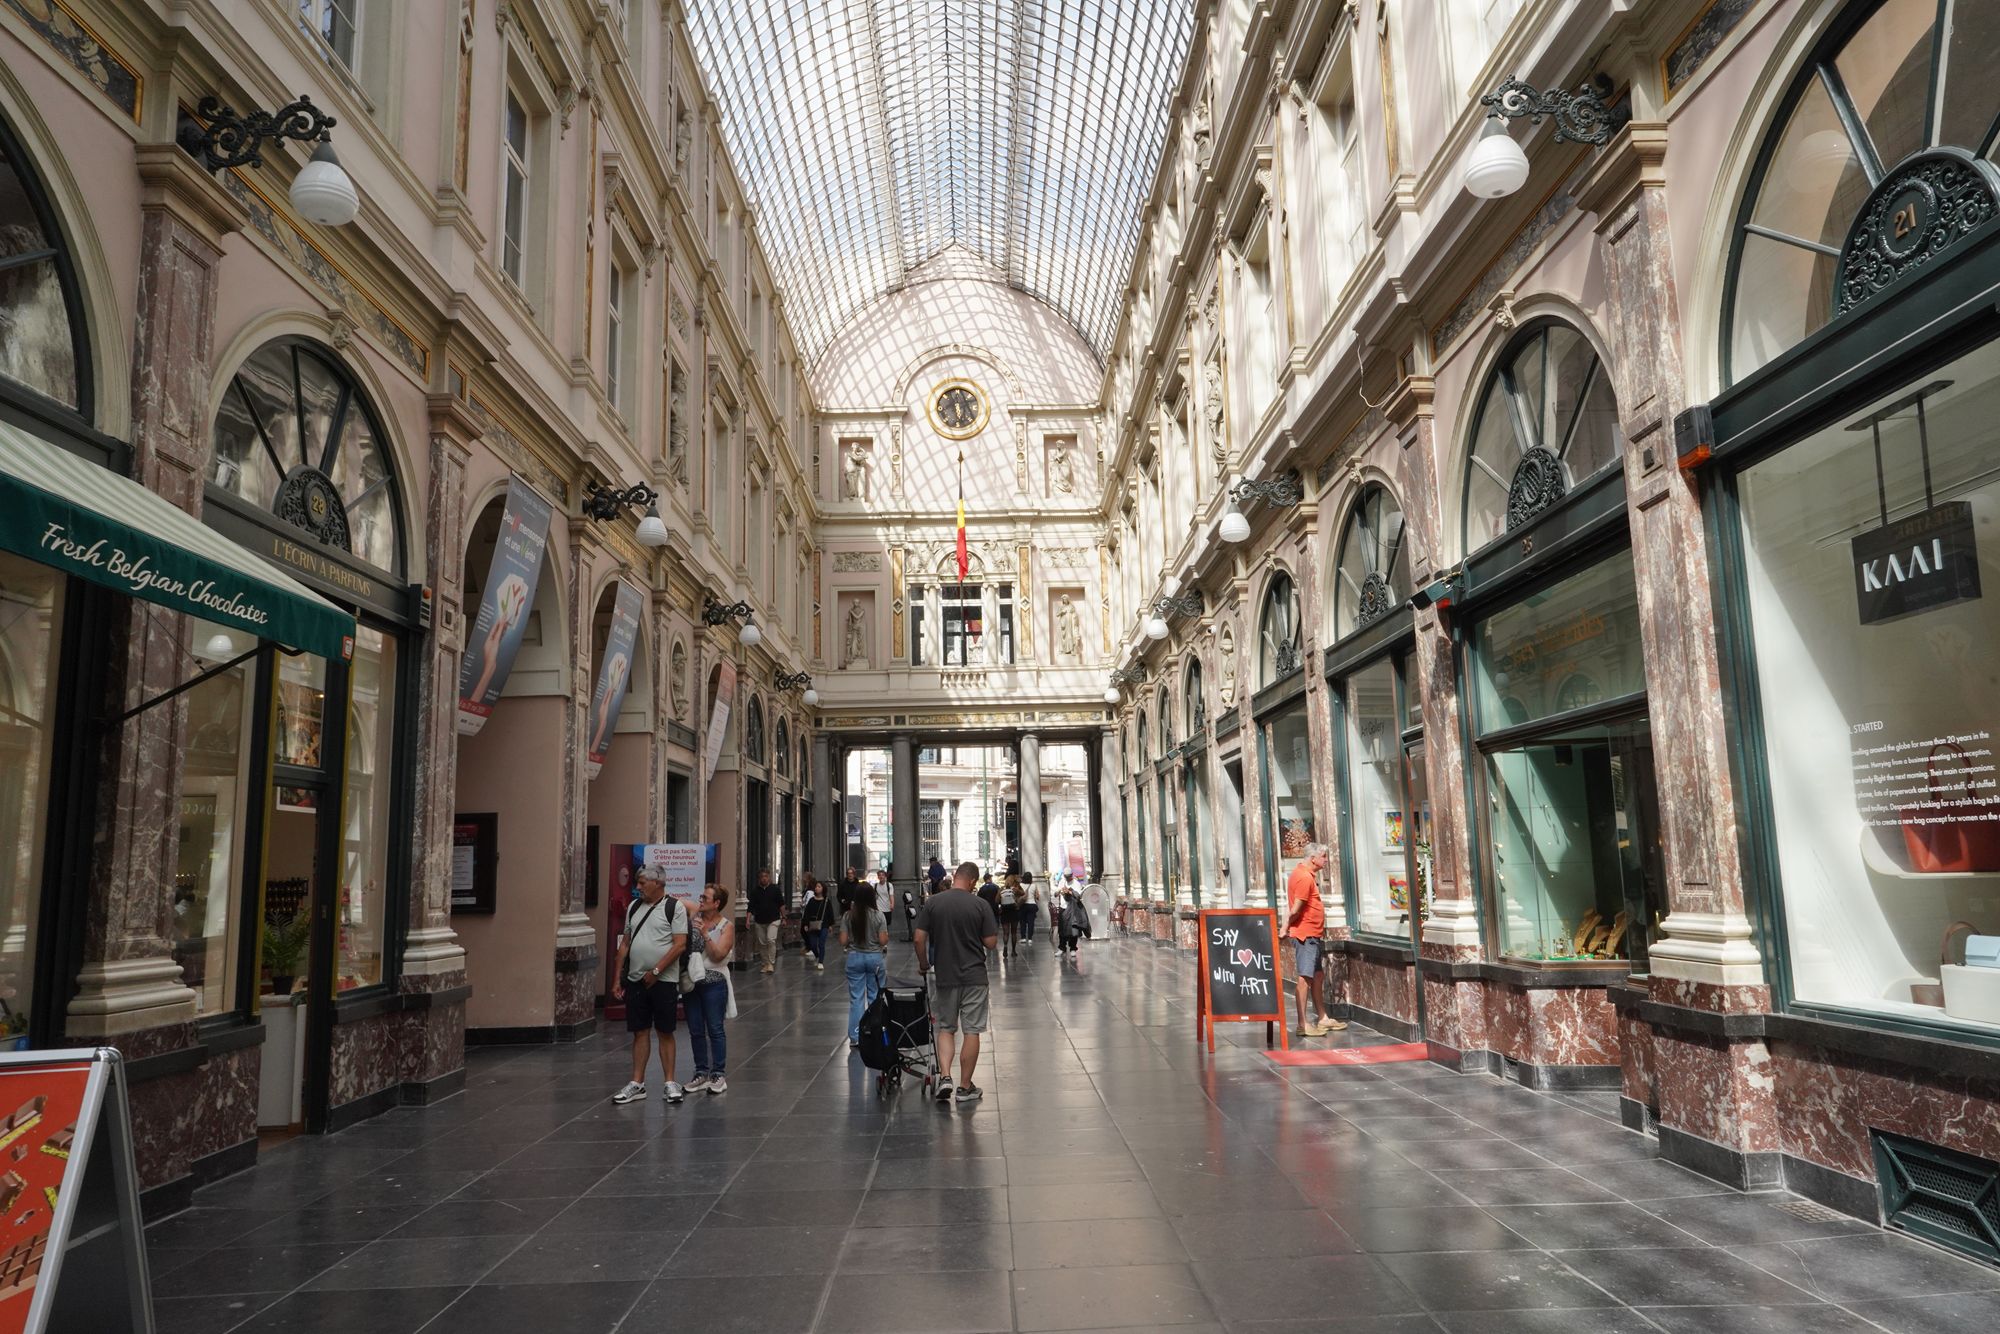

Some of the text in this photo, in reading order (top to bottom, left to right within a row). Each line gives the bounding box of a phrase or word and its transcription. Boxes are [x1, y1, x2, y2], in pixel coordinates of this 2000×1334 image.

[1892, 203, 1917, 240] 21
[311, 495, 326, 515] 28
[40, 522, 268, 625] Fresh Belgian Chocolates
[329, 564, 371, 598] PARFUMS
[1853, 720, 1884, 734] STARTED
[1870, 744, 1886, 754] around
[1887, 744, 1896, 752] the
[1896, 742, 1910, 752] globe
[1911, 740, 1920, 748] for
[1934, 736, 1946, 745] than
[1946, 735, 1956, 744] 20
[1956, 734, 1972, 744] years
[1980, 730, 1990, 739] the
[1929, 753, 1951, 762] meeting
[1963, 748, 1992, 758] reception,
[1906, 771, 1929, 780] morning.
[1929, 768, 1942, 776] Their
[1943, 767, 1958, 776] main
[1874, 789, 1883, 797] lots
[1883, 788, 1889, 796] of
[1889, 786, 1917, 798] paperwork
[1917, 784, 1929, 793] and
[1928, 783, 1953, 792] women's
[1967, 780, 1975, 789] all
[1976, 778, 1997, 788] stuffed
[1889, 800, 1920, 812] Desperately
[1920, 799, 1941, 810] looking
[1940, 799, 1949, 807] for
[1955, 797, 1973, 808] stylish
[1972, 796, 1986, 806] bag
[1913, 816, 1925, 826] bag
[1925, 815, 1948, 824] concept
[1947, 814, 1956, 822] for
[1987, 811, 1998, 820] the
[1212, 928, 1239, 946] SAY
[1214, 966, 1235, 985] WITH
[1240, 976, 1269, 996] ART
